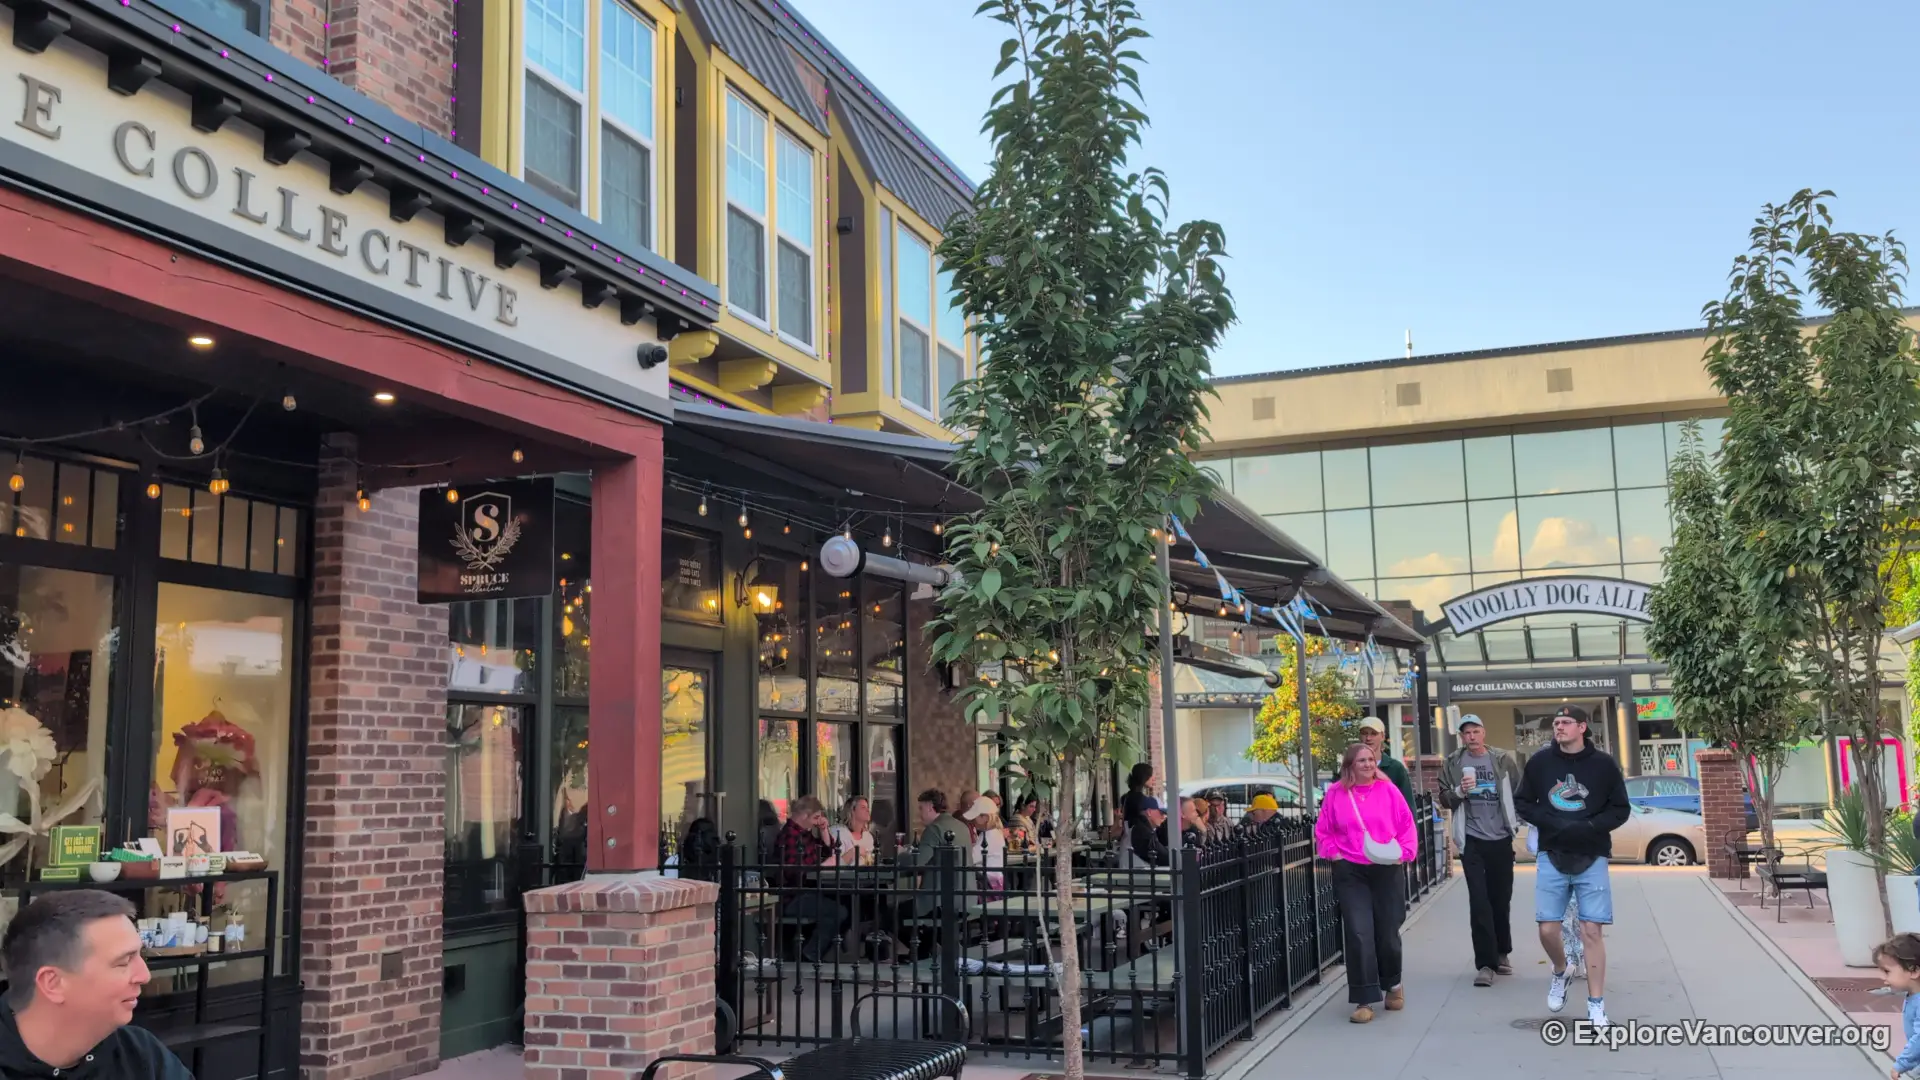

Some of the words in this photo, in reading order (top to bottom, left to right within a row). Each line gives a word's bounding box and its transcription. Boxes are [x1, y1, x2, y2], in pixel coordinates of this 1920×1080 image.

[114, 120, 518, 327] COLLECTIVE
[473, 503, 499, 542] S
[459, 572, 510, 586] SPRUCE
[1450, 585, 1539, 626] WOOLLY
[1544, 583, 1590, 605] DOG
[1474, 681, 1534, 692] CHILLIWACK
[1534, 680, 1578, 690] BUSINESS
[1578, 678, 1617, 688] CENTRE
